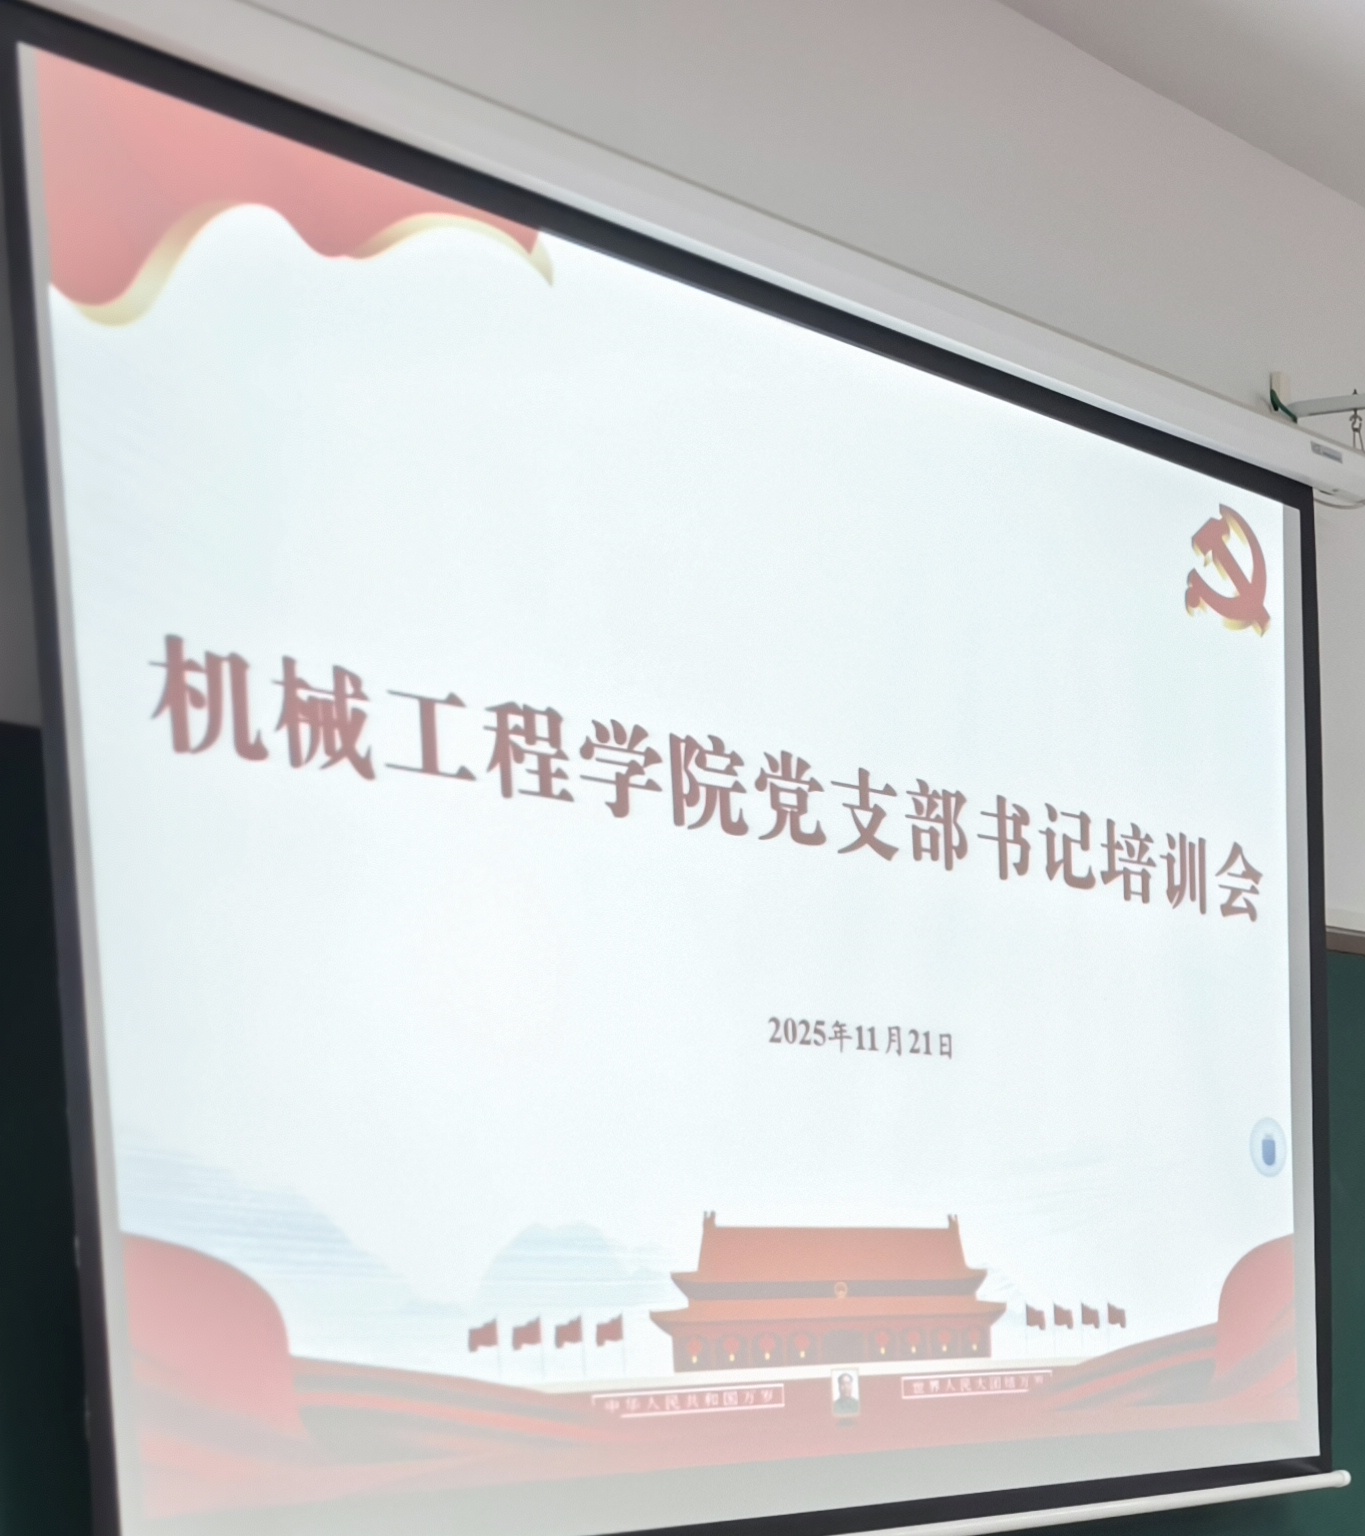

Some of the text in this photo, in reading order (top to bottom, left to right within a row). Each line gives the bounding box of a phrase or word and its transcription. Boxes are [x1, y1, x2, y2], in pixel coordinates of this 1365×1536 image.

[147, 633, 1264, 923] 机械工程学院党支部书记培训会
[767, 1016, 954, 1060] 2025年11月21日
